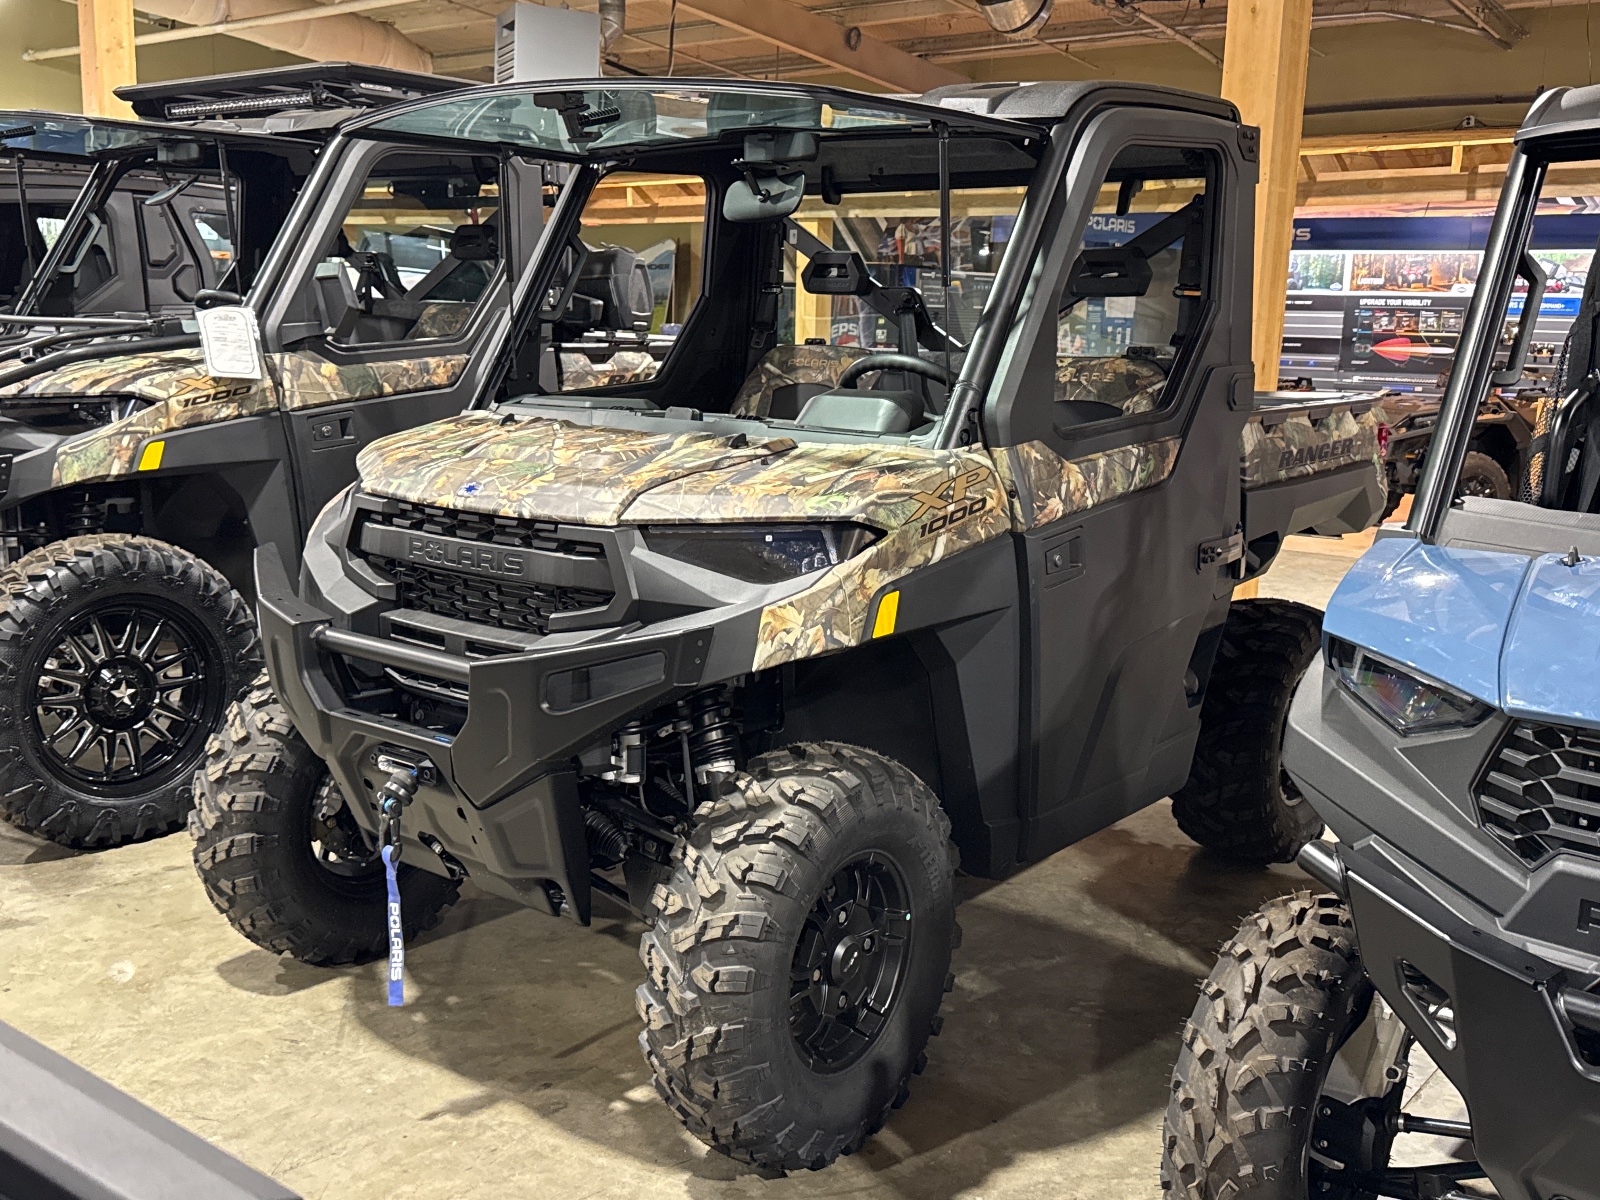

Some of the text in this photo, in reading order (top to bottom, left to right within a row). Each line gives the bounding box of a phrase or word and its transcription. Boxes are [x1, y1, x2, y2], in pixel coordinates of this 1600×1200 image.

[831, 322, 859, 338] EPS
[182, 385, 252, 408] 1000
[1278, 438, 1354, 470] RANGER
[901, 465, 992, 528] XP
[920, 497, 987, 538] 1000
[409, 537, 525, 576] POLARIS
[389, 902, 404, 981] POLARIS
